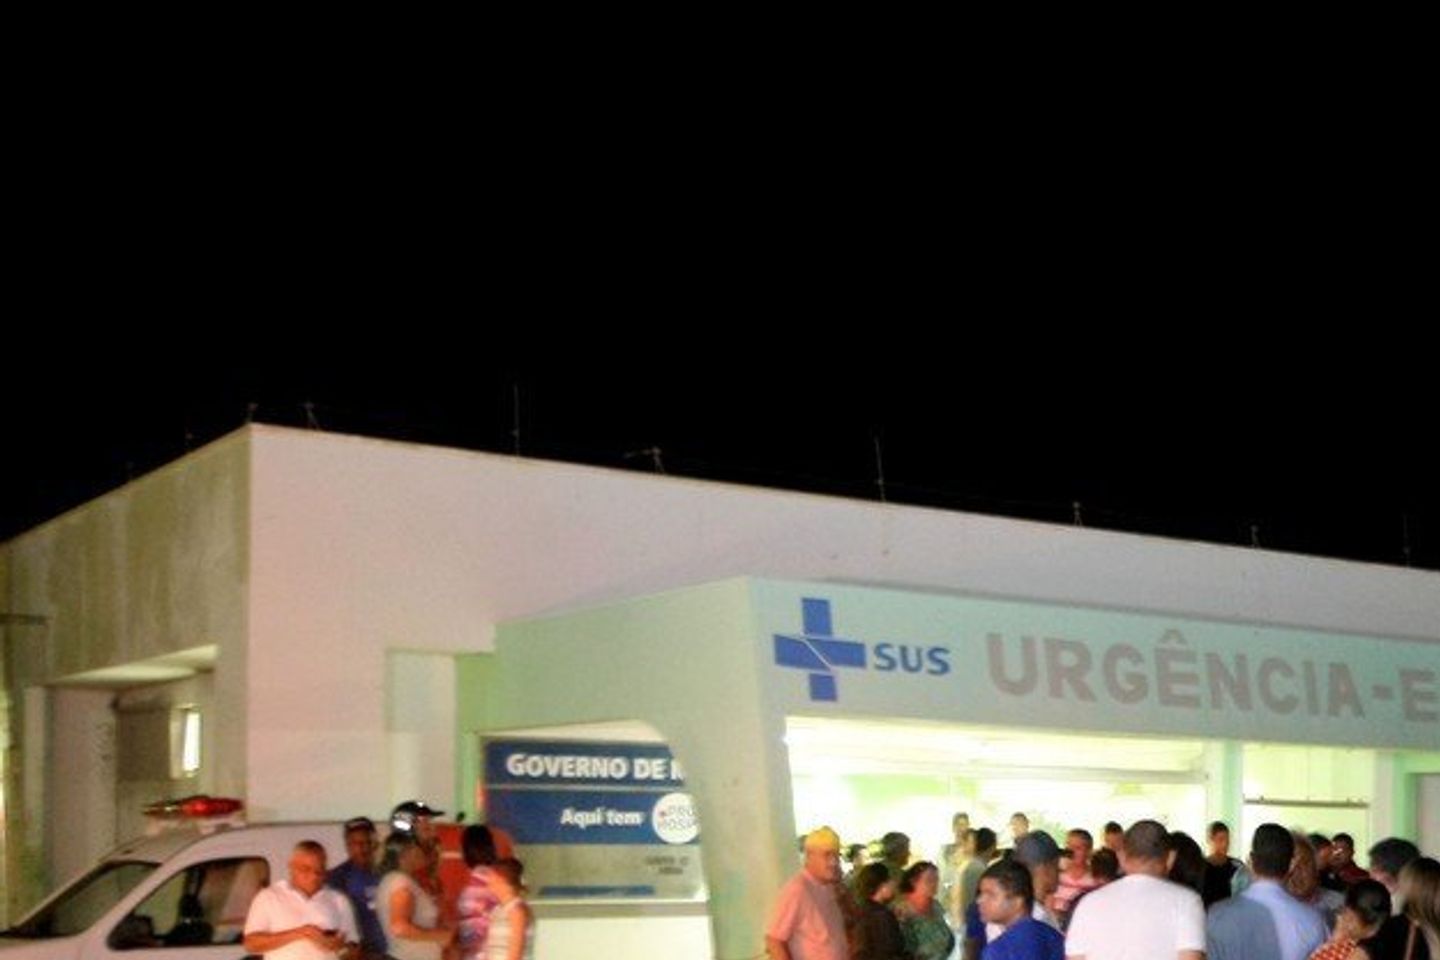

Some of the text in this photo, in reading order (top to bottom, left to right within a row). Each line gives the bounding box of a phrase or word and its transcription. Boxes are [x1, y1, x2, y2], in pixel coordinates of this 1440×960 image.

[873, 641, 952, 676] SUS
[506, 753, 628, 780] GOVERNO
[633, 757, 667, 780] DE
[560, 807, 602, 828] Aqui
[605, 809, 643, 826] tem
